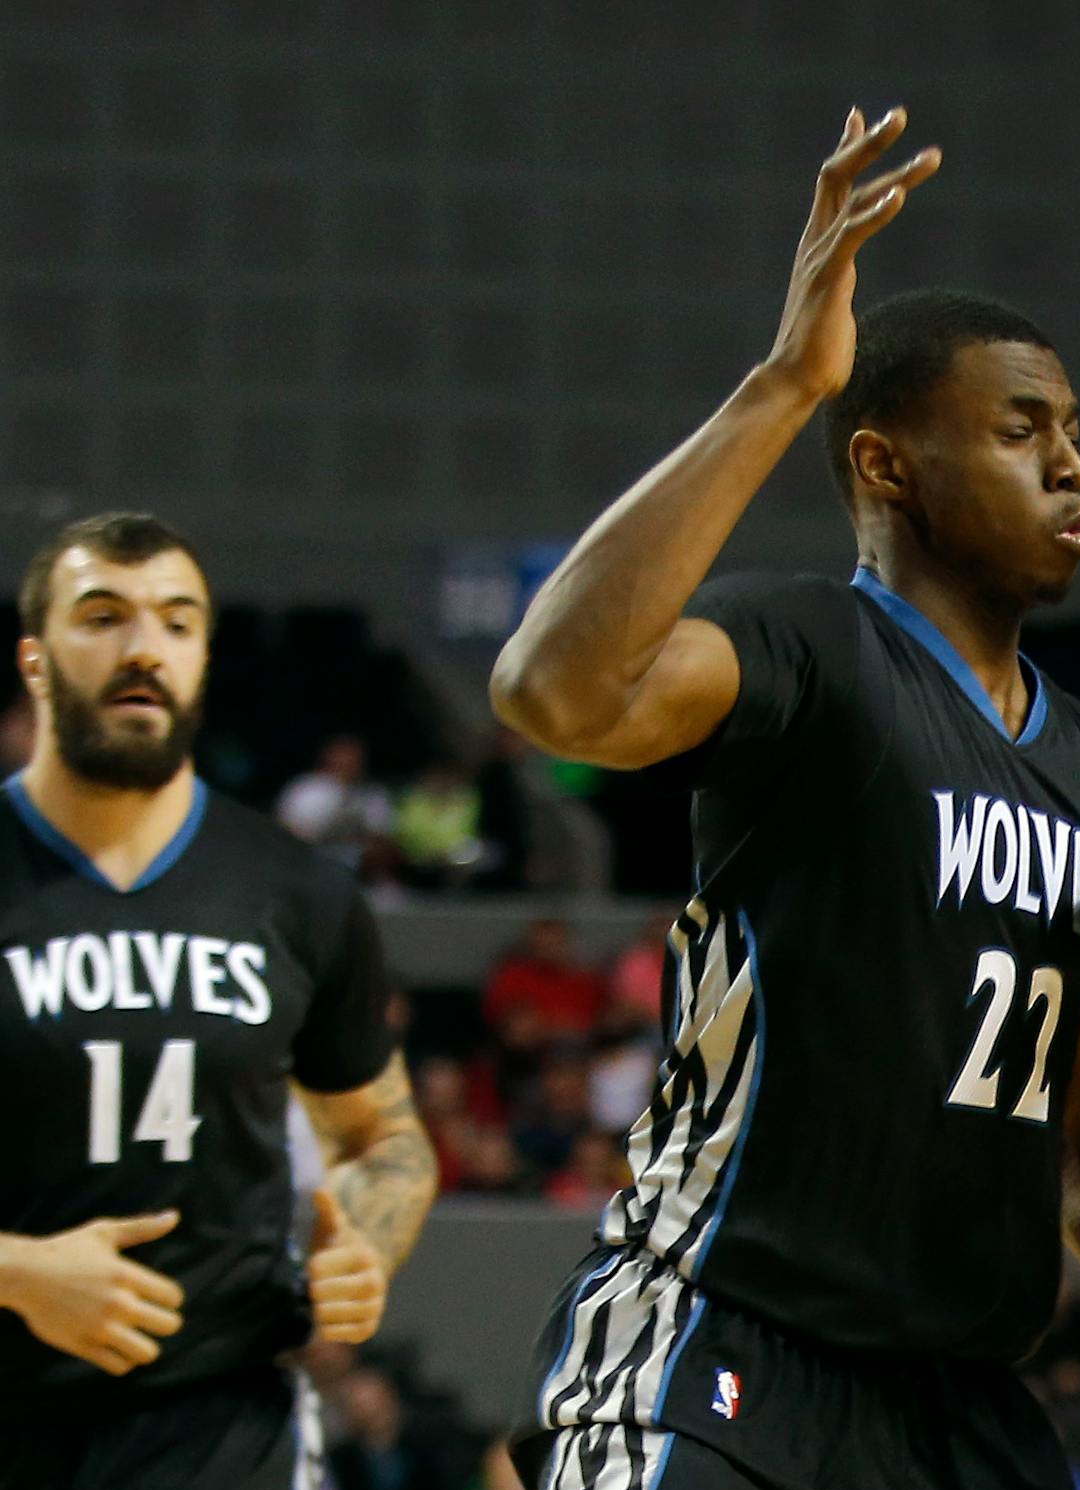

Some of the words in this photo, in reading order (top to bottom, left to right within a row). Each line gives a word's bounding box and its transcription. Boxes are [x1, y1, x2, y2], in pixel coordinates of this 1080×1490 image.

[4, 930, 271, 1025] WOLVES
[946, 946, 1063, 1123] 22
[82, 1038, 202, 1164] 14
